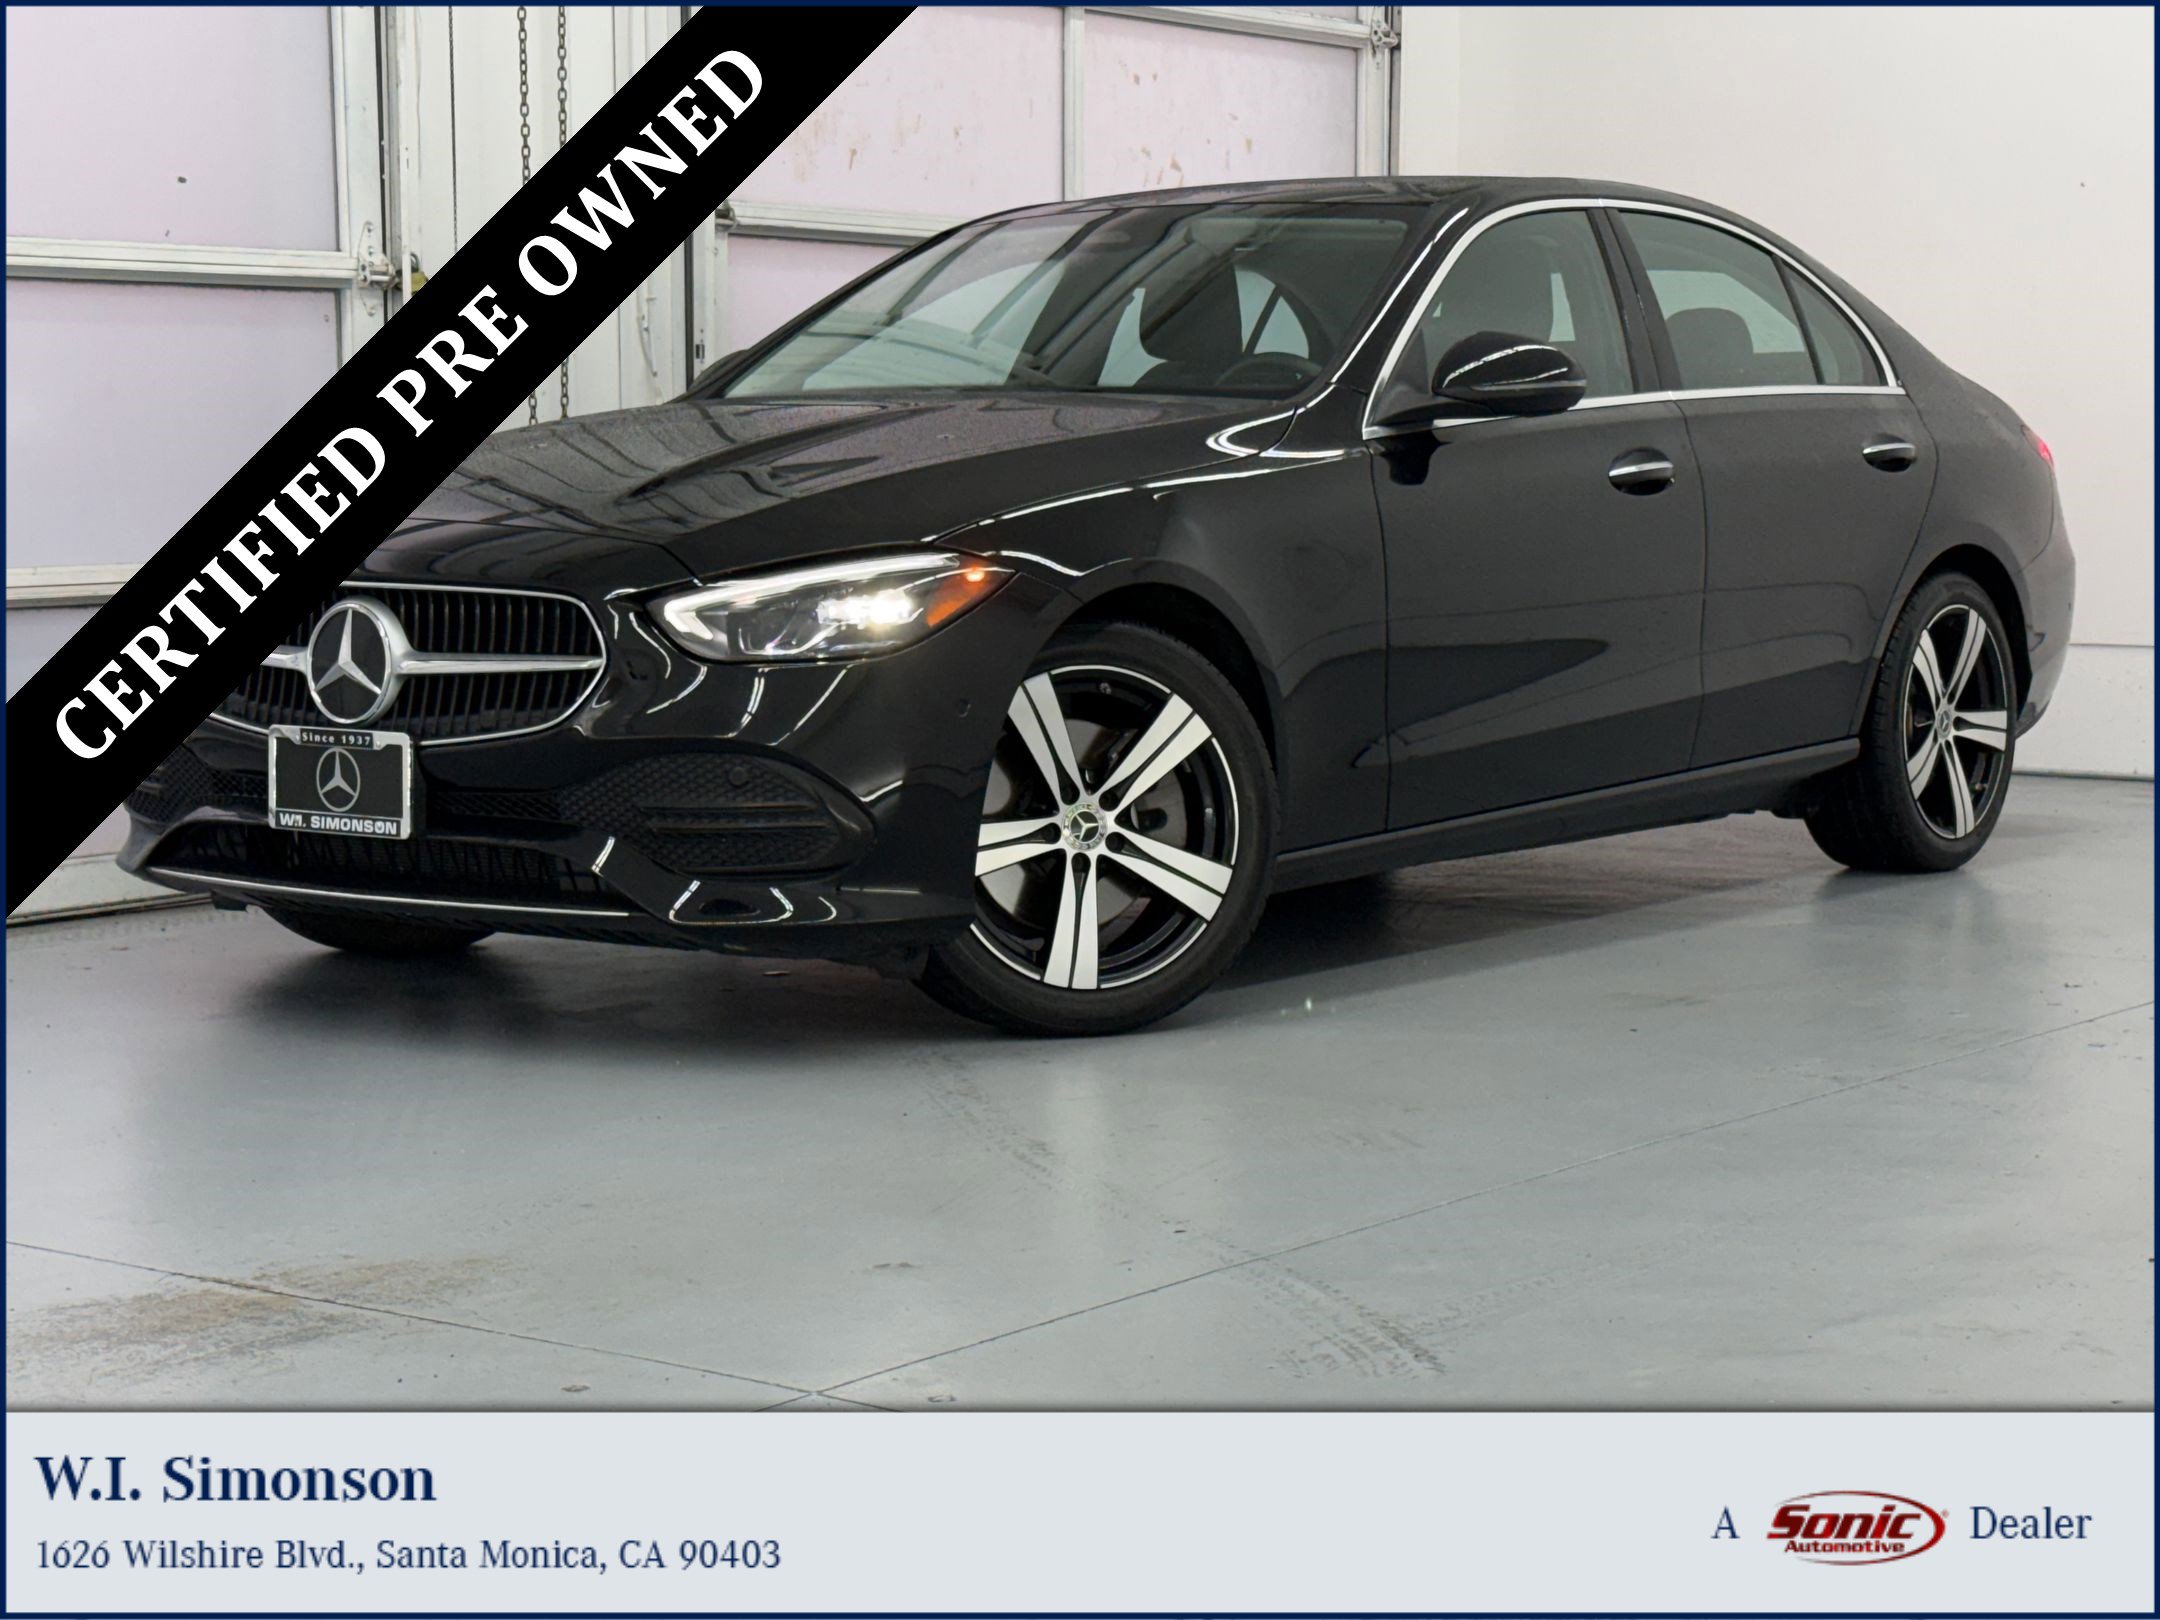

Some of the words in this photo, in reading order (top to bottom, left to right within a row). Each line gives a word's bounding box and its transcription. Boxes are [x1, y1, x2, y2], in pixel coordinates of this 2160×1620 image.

[301, 732, 335, 743] Since
[341, 735, 371, 745] 1937
[311, 816, 397, 835] SIMONSON
